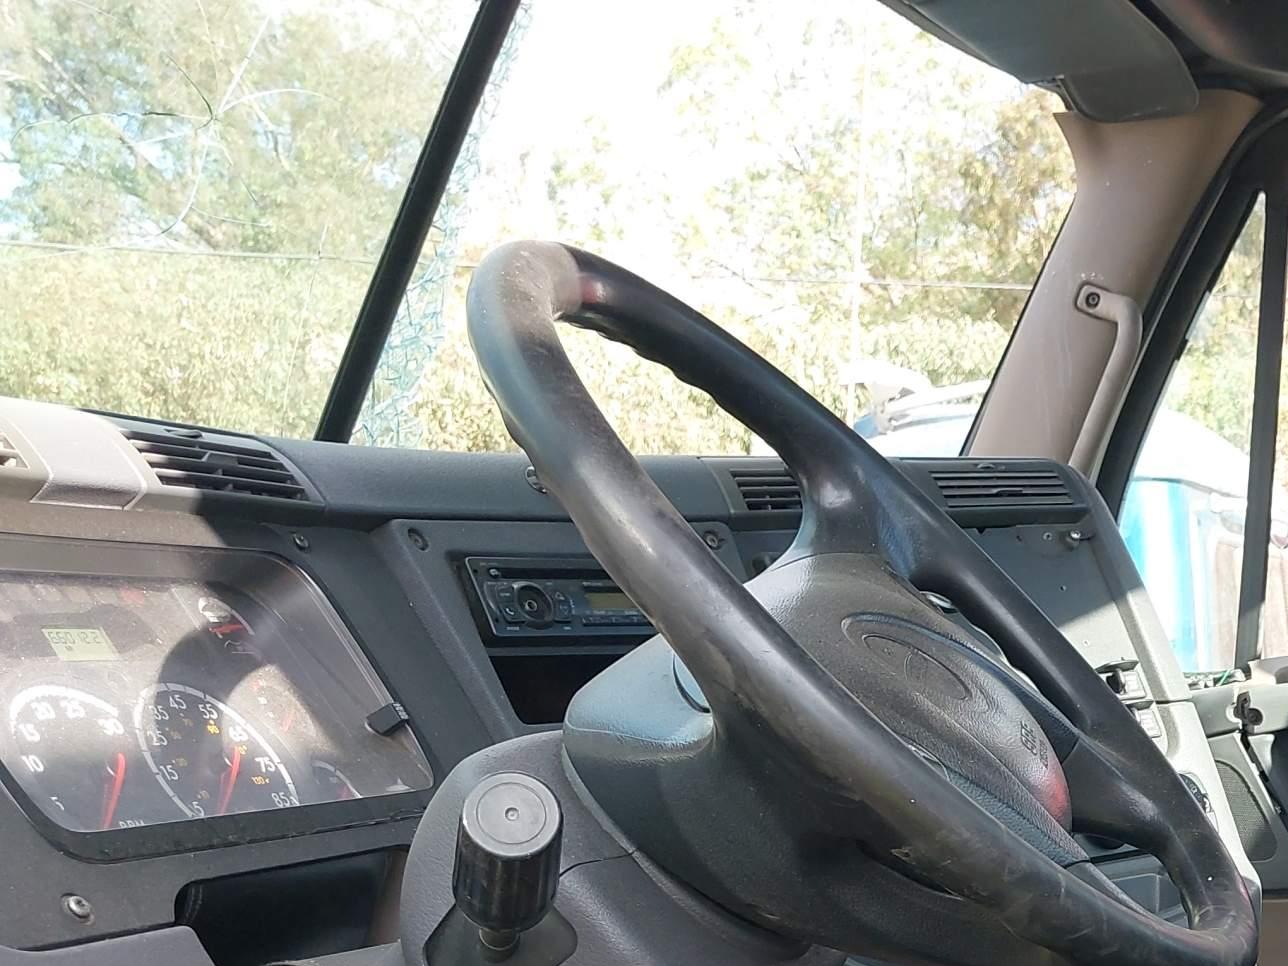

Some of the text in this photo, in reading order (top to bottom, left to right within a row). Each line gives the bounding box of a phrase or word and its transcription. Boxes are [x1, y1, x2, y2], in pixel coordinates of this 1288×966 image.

[169, 694, 187, 710] 45
[149, 705, 169, 721] 35
[199, 704, 218, 719] 55
[96, 718, 125, 736] 30
[228, 725, 249, 742] 65
[147, 730, 168, 746] 25
[21, 755, 45, 772] 10
[254, 757, 276, 772] 75
[160, 765, 179, 780] 15
[271, 792, 290, 808] 85
[192, 801, 205, 817] 5
